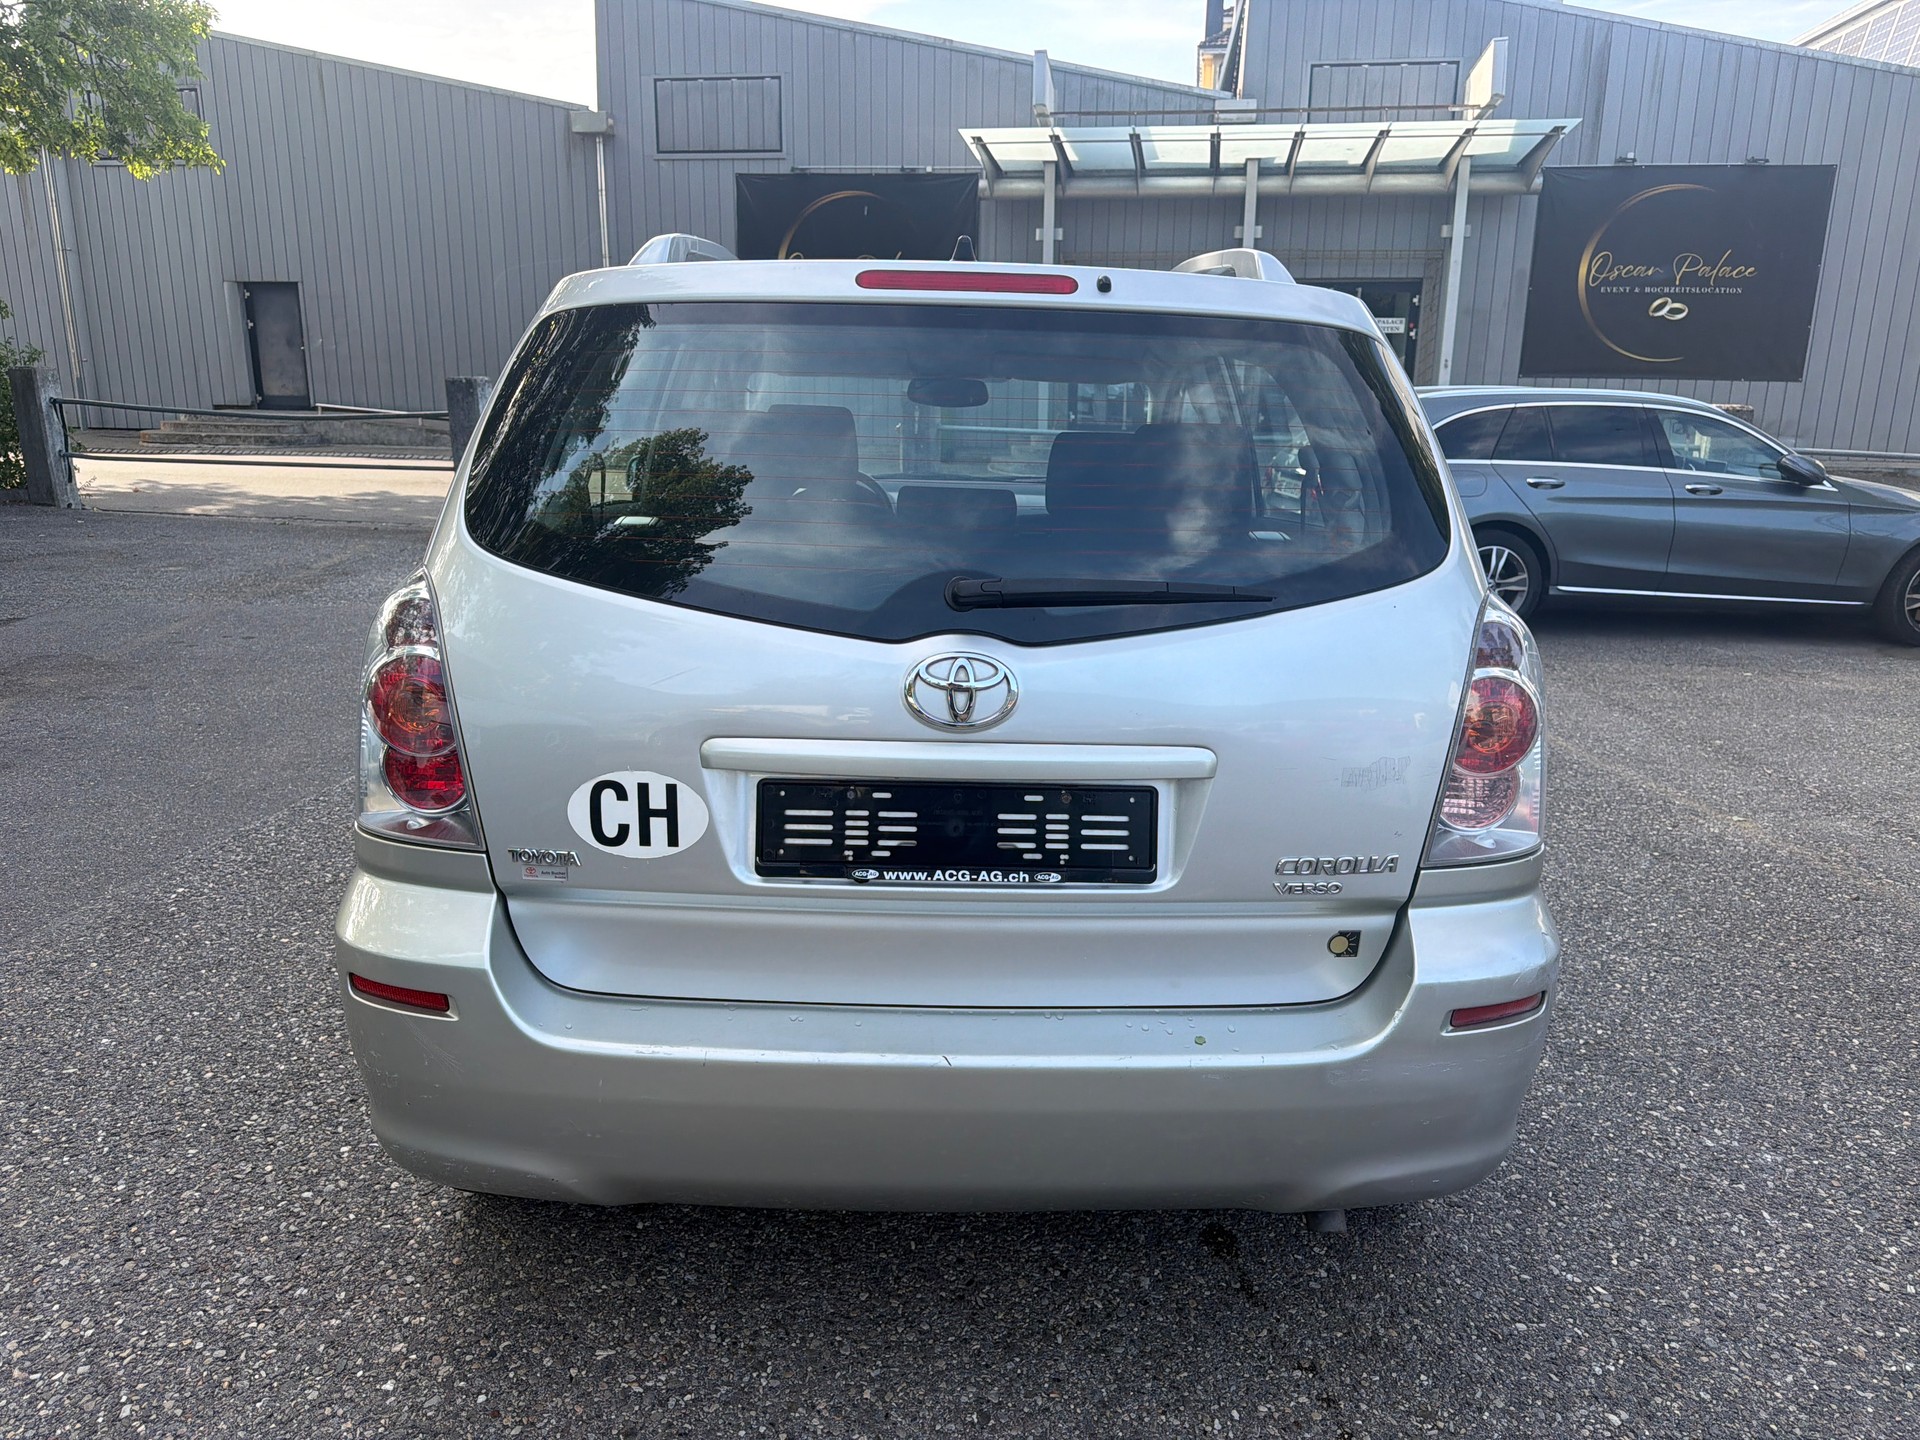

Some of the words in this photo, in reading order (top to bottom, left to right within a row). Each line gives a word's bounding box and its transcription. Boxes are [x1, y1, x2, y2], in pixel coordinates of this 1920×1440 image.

[1589, 251, 1664, 287] Oscar
[1673, 249, 1758, 286] Palace
[1644, 286, 1743, 294] HOCHZEITSLOCATION
[589, 779, 679, 848] CH
[507, 848, 582, 867] TOYOTA
[1275, 853, 1399, 876] COROLLA
[854, 870, 878, 878] ACG-AG
[883, 869, 1030, 883] www.ACG-AG.ch
[1036, 873, 1060, 881] ACG-AG
[1272, 881, 1343, 896] VERSO
